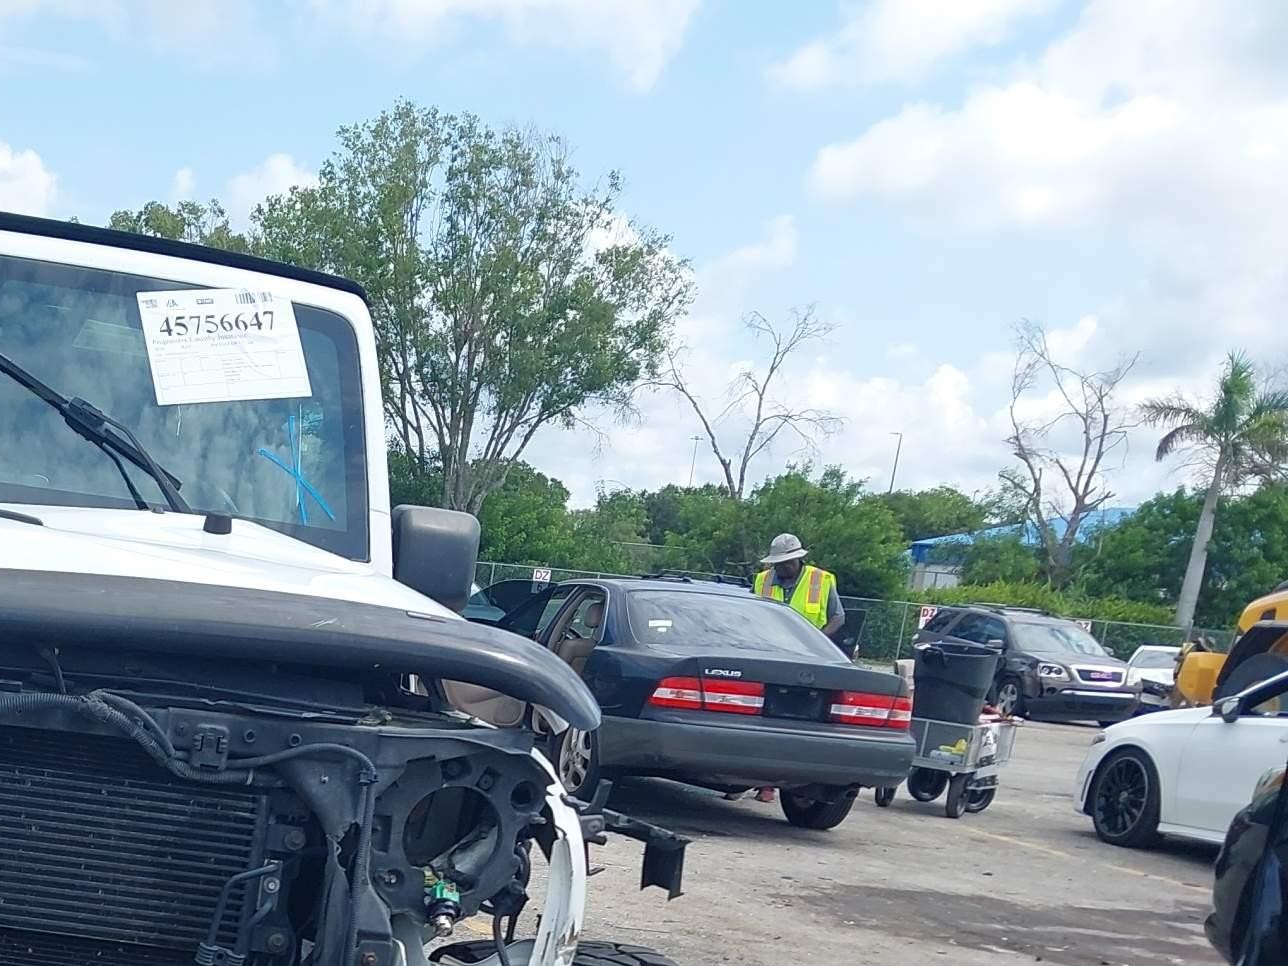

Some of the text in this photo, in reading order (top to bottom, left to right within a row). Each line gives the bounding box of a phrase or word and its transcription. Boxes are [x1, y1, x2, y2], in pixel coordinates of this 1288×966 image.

[159, 311, 274, 336] 45756647
[535, 570, 549, 580] DZ
[922, 609, 935, 617] DZ
[704, 668, 742, 677] LEXUS
